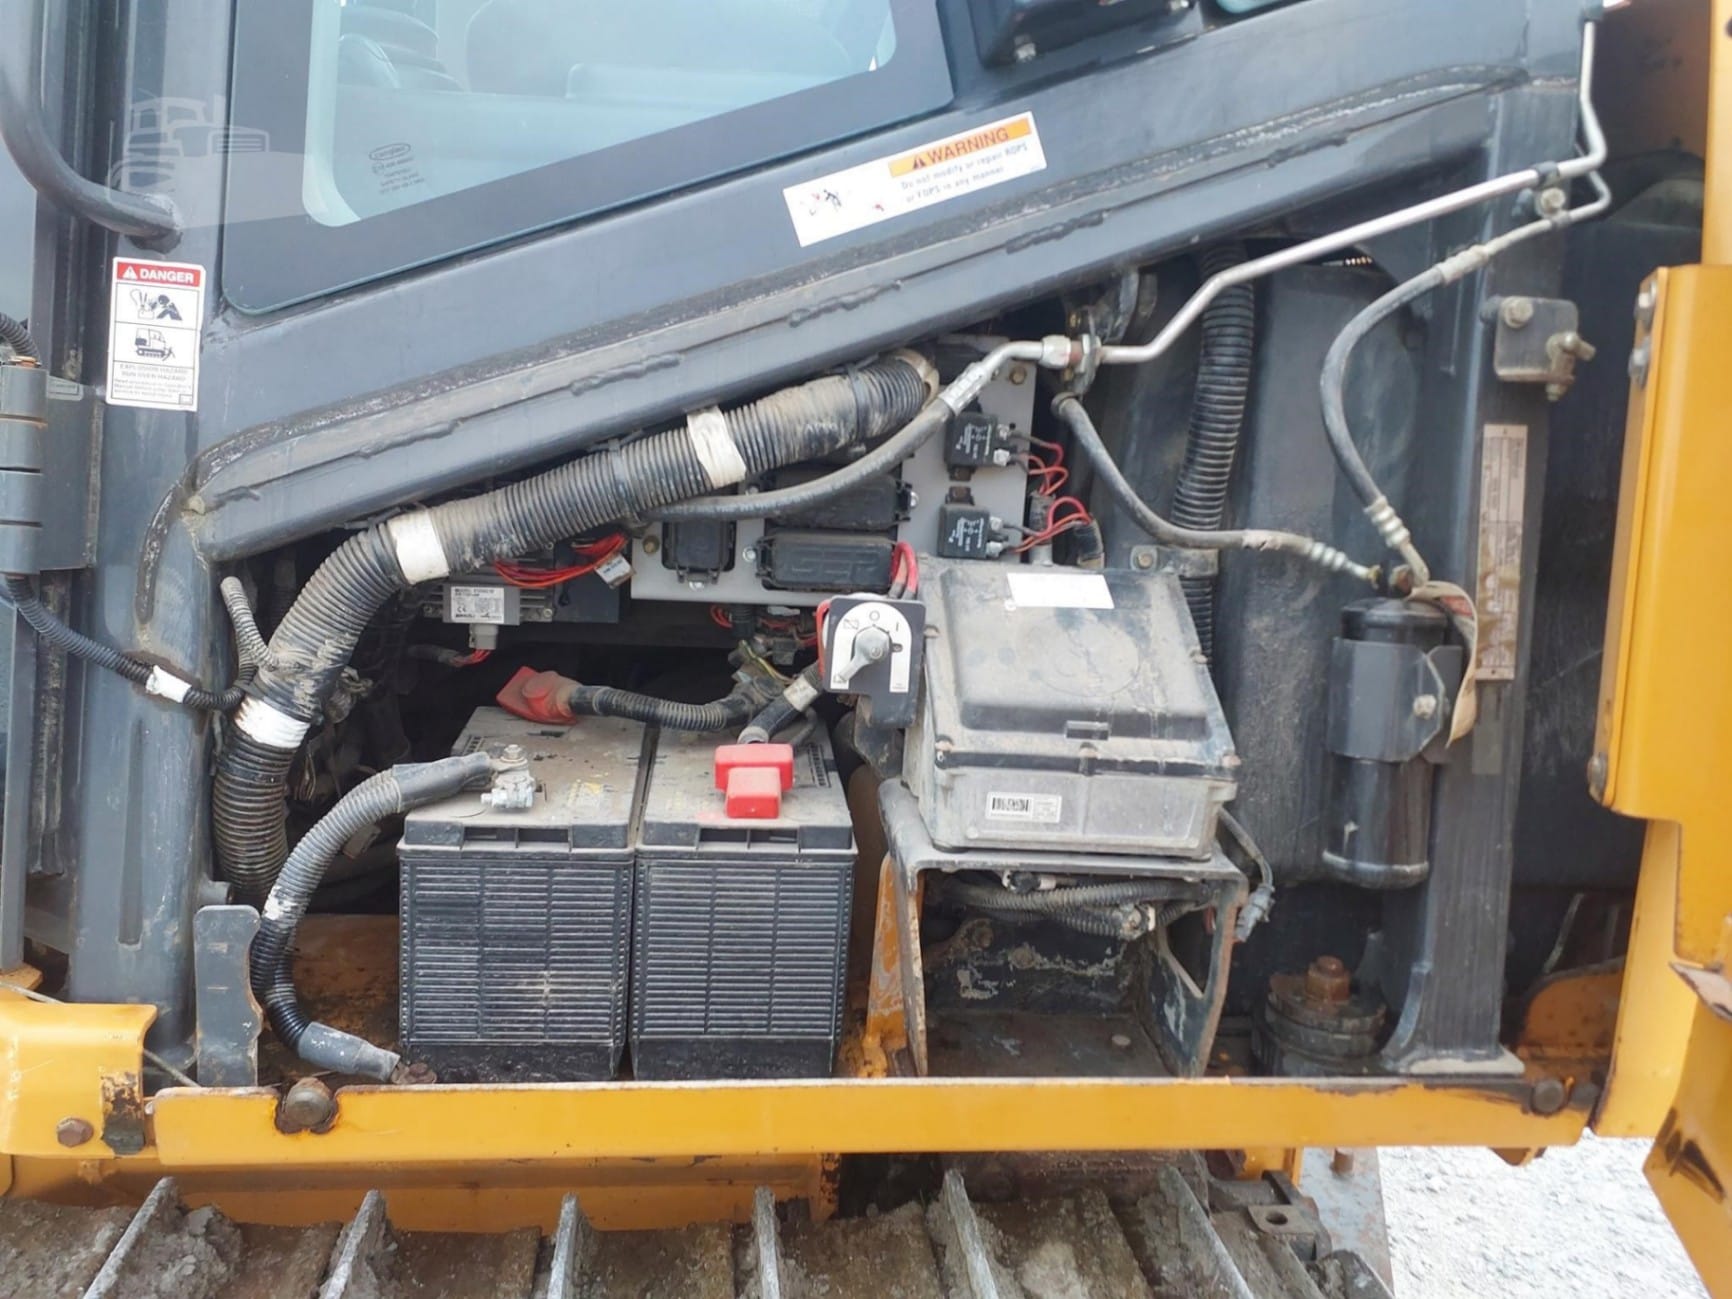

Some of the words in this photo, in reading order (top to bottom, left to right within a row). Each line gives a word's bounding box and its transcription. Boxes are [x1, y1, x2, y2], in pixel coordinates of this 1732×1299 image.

[926, 127, 1010, 164] WARNING
[901, 180, 914, 191] Do
[916, 174, 931, 185] not
[933, 163, 963, 180] modify
[977, 152, 1003, 168] repair
[1005, 142, 1028, 158] ROPS
[955, 177, 970, 189] any
[972, 167, 1005, 182] manner
[139, 268, 194, 284] DANGER
